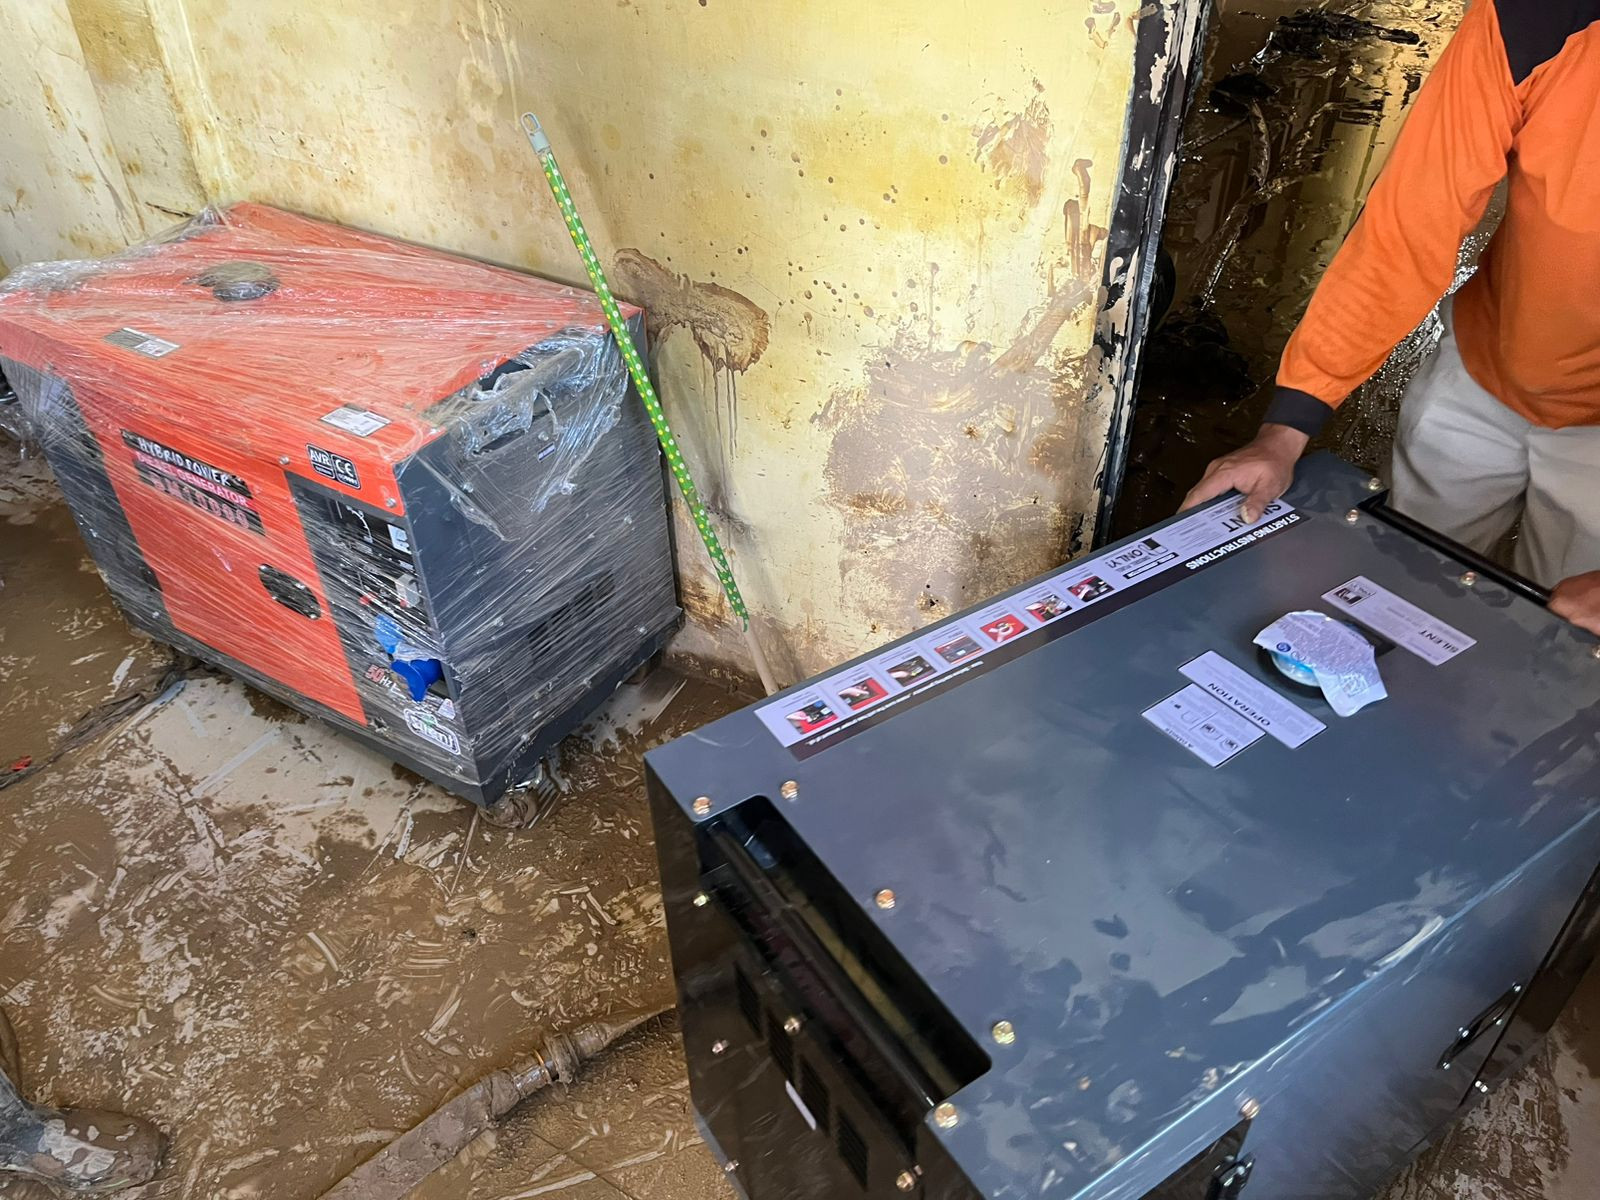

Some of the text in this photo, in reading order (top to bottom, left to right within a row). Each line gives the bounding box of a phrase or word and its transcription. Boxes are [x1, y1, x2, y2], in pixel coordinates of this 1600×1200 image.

[137, 437, 184, 466] HYBRID
[309, 449, 332, 466] AVR
[176, 468, 250, 507] GENERATOR
[1254, 513, 1300, 538] STARTING
[1105, 549, 1143, 569] ONLY!
[1185, 534, 1257, 570] INSTRUCTIONS
[1207, 682, 1271, 727] OPERATION
